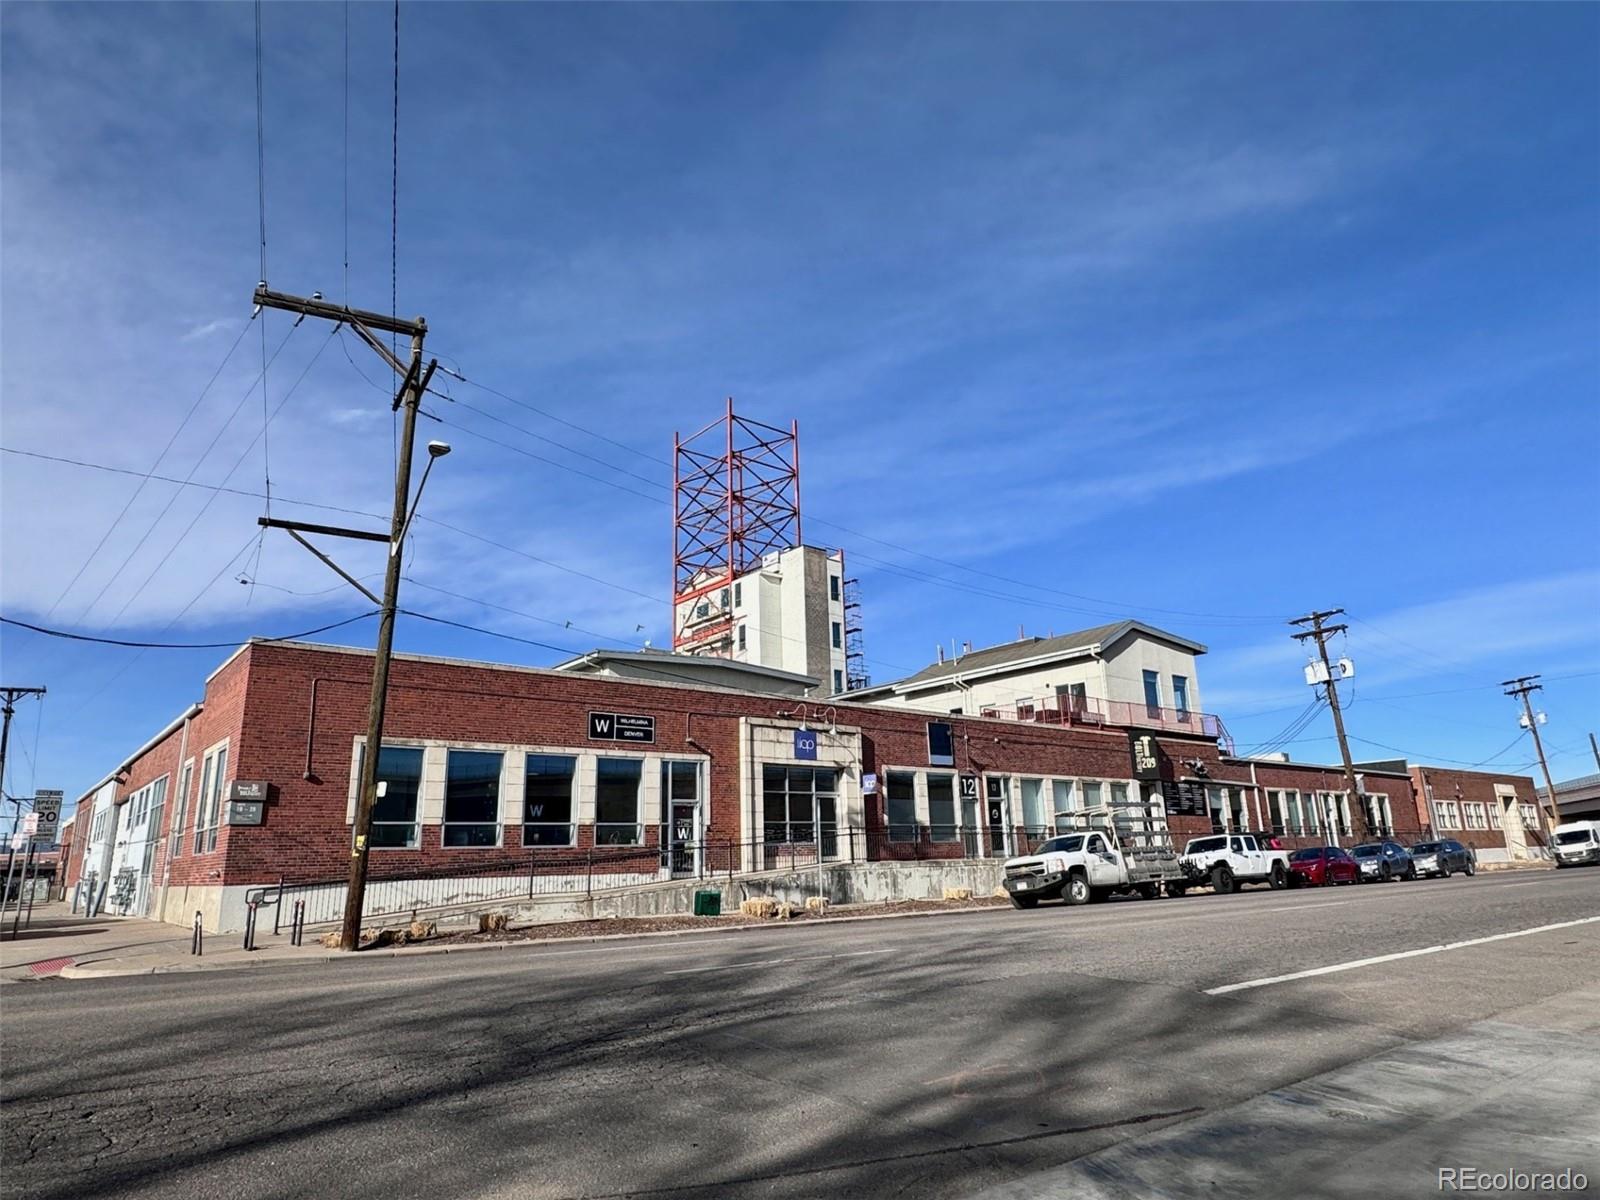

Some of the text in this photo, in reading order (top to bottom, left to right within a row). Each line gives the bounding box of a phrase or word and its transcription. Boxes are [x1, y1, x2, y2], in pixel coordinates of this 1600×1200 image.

[595, 719, 610, 733] W
[1141, 757, 1156, 769] 209
[962, 778, 975, 794] 12
[38, 811, 57, 822] 20
[529, 804, 544, 817] W
[677, 827, 689, 840] W
